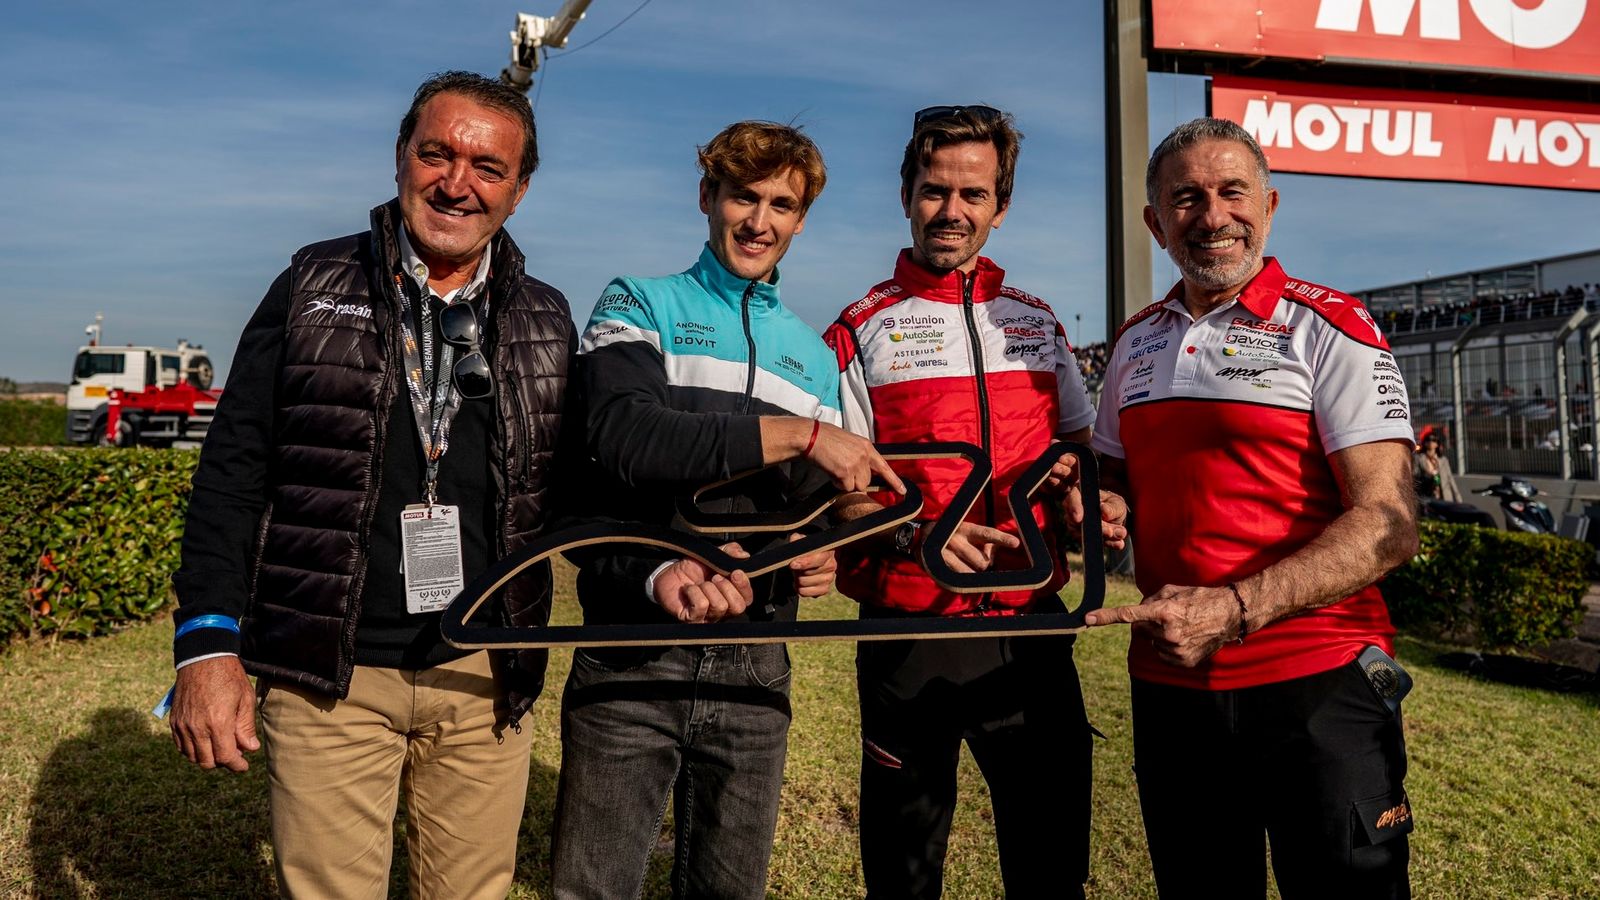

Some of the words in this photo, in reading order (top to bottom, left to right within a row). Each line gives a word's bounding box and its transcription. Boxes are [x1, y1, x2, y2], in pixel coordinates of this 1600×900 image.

[1241, 99, 1443, 157] MOTUL
[899, 315, 945, 325] solunion
[676, 321, 715, 333] ANONIMO
[1004, 326, 1046, 337] GASGAS
[902, 330, 945, 341] AutoSolar
[674, 336, 717, 349] DOVIT
[1225, 334, 1289, 352] gaviota
[424, 331, 433, 371] PREMIUM
[894, 348, 935, 358] ASTERIUS
[1005, 342, 1047, 357] aspar
[1234, 349, 1281, 360] AutoSolar
[1215, 366, 1279, 380] aspar
